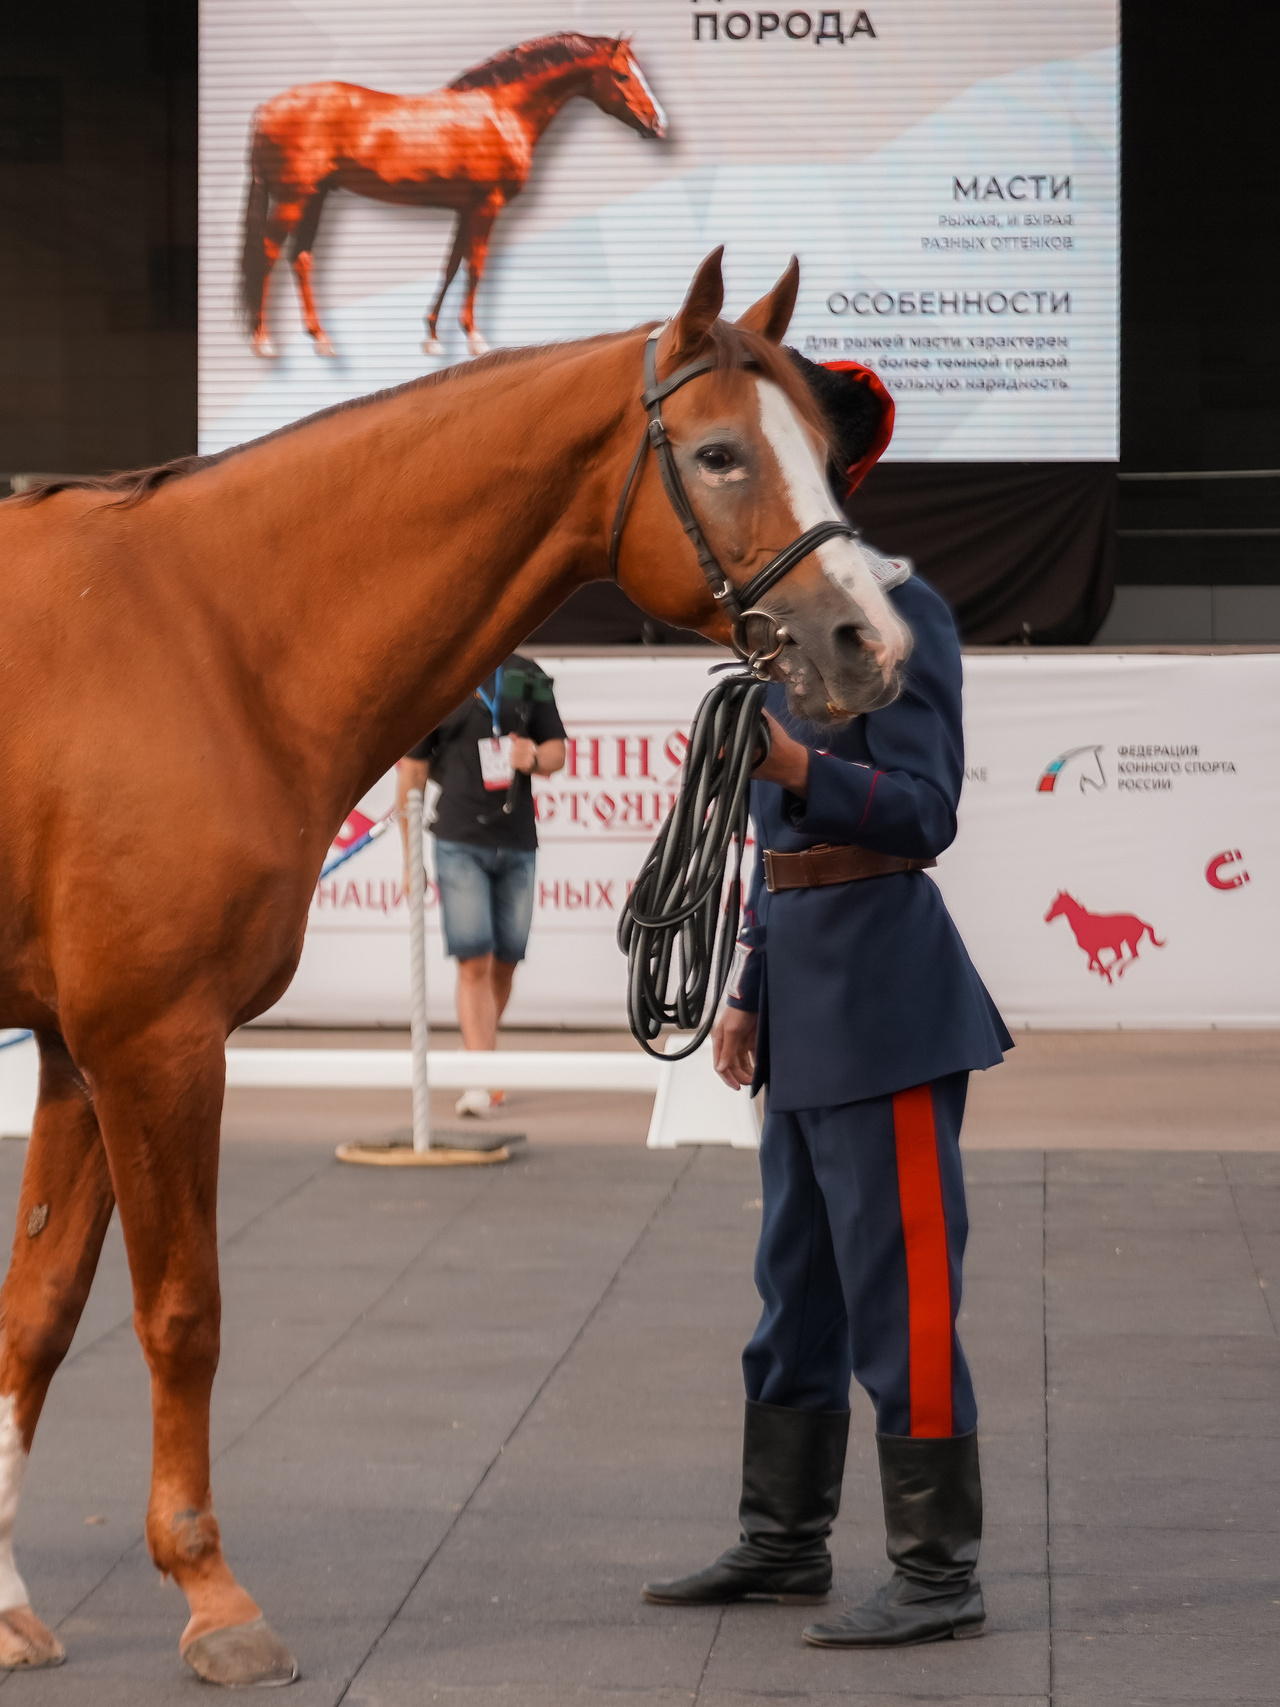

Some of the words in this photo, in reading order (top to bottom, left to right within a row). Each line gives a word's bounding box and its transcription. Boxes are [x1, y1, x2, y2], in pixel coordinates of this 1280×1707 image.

[693, 10, 877, 44] ПОРОДА
[953, 174, 1071, 200] МАСТИ
[1007, 214, 1017, 226] И
[1023, 214, 1072, 226] БУРАЯ
[921, 236, 985, 249] РАЗНЫХ
[990, 236, 1073, 249] ОТТЕНКОВ
[827, 291, 1071, 315] ОСОБЕННОСТИ
[805, 336, 838, 350] Для
[843, 334, 904, 350] рыжей
[909, 336, 961, 347] масти
[966, 336, 1068, 350] характерен
[878, 354, 930, 369] более
[935, 354, 1000, 369] темной
[1005, 354, 1068, 370] гривой
[1118, 744, 1199, 757] ФЕДЕРАЦИЯ
[1118, 761, 1181, 773] КОННОГО
[1184, 761, 1236, 773] СПОРТА
[1118, 778, 1171, 790] РОССИИ
